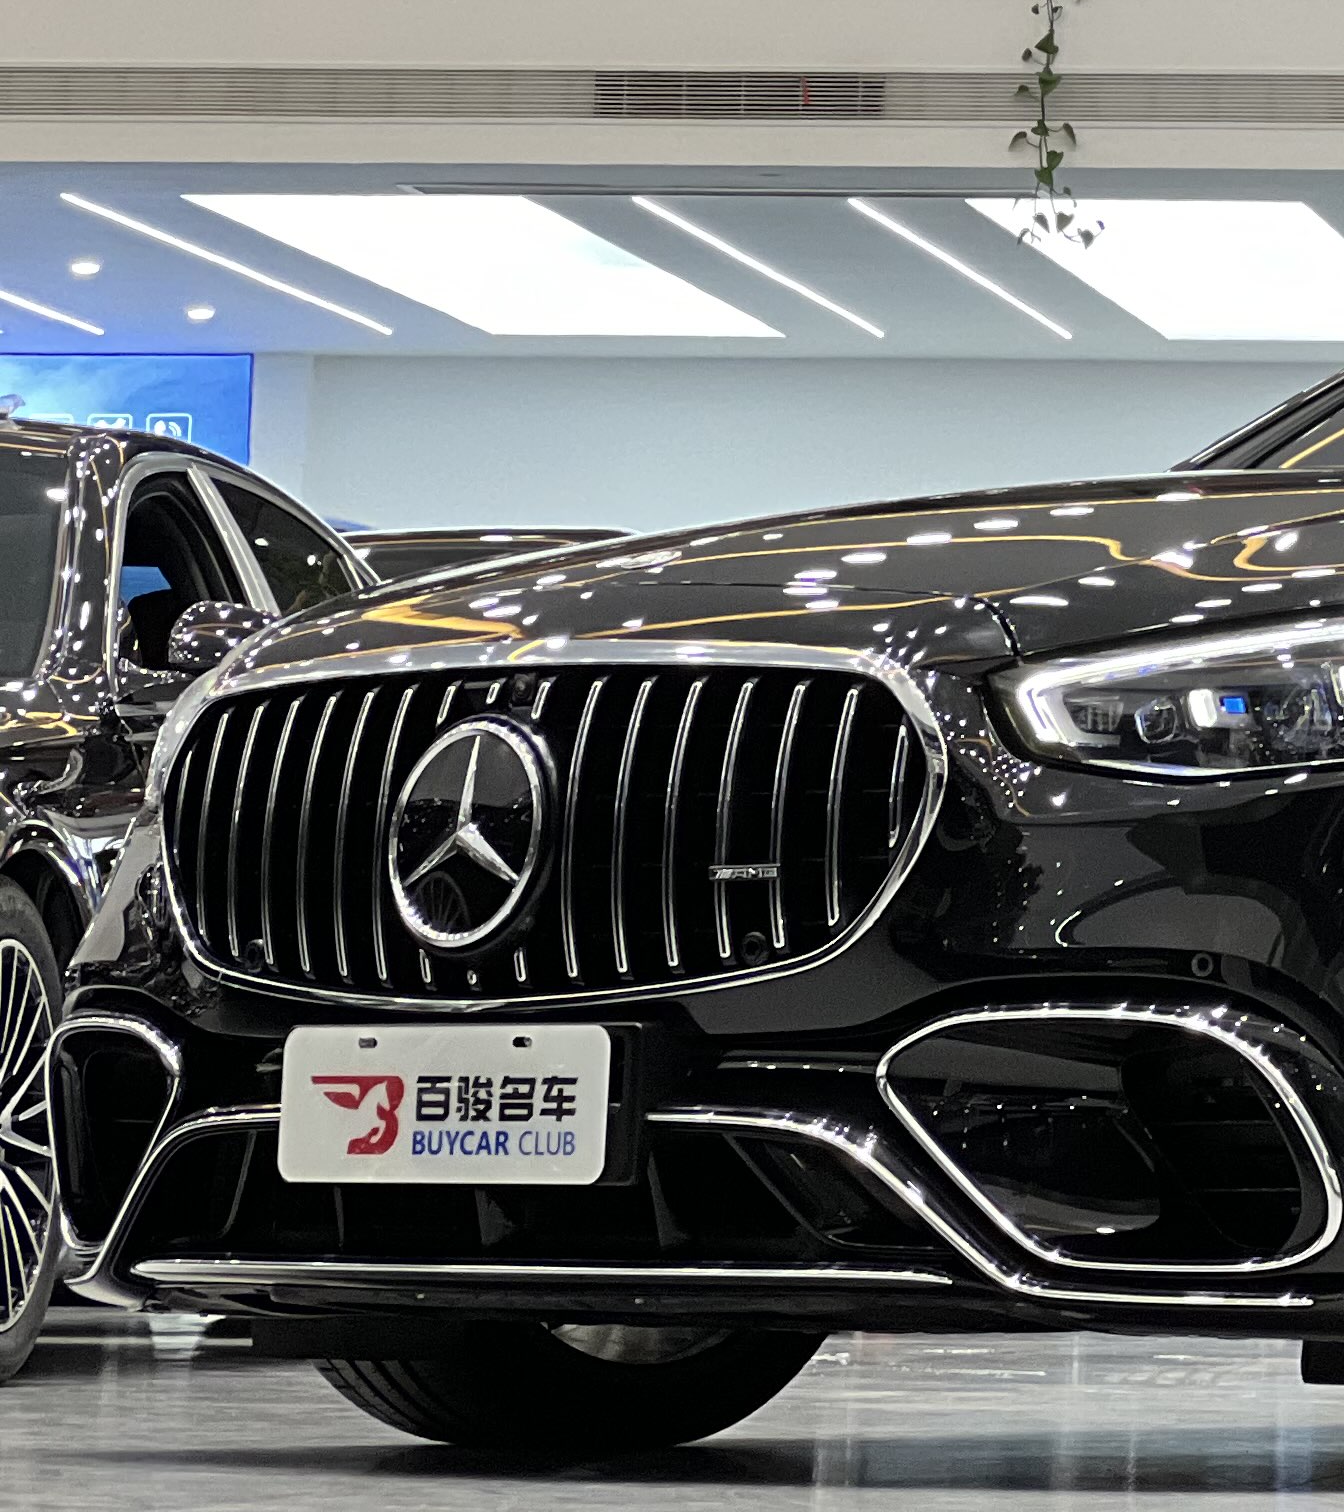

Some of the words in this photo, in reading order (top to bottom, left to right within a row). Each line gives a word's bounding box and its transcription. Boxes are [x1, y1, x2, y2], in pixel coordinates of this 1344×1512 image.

[415, 1075, 579, 1122] 百骏名车
[411, 1130, 509, 1156] BUYCAR
[518, 1130, 576, 1156] CLUB
